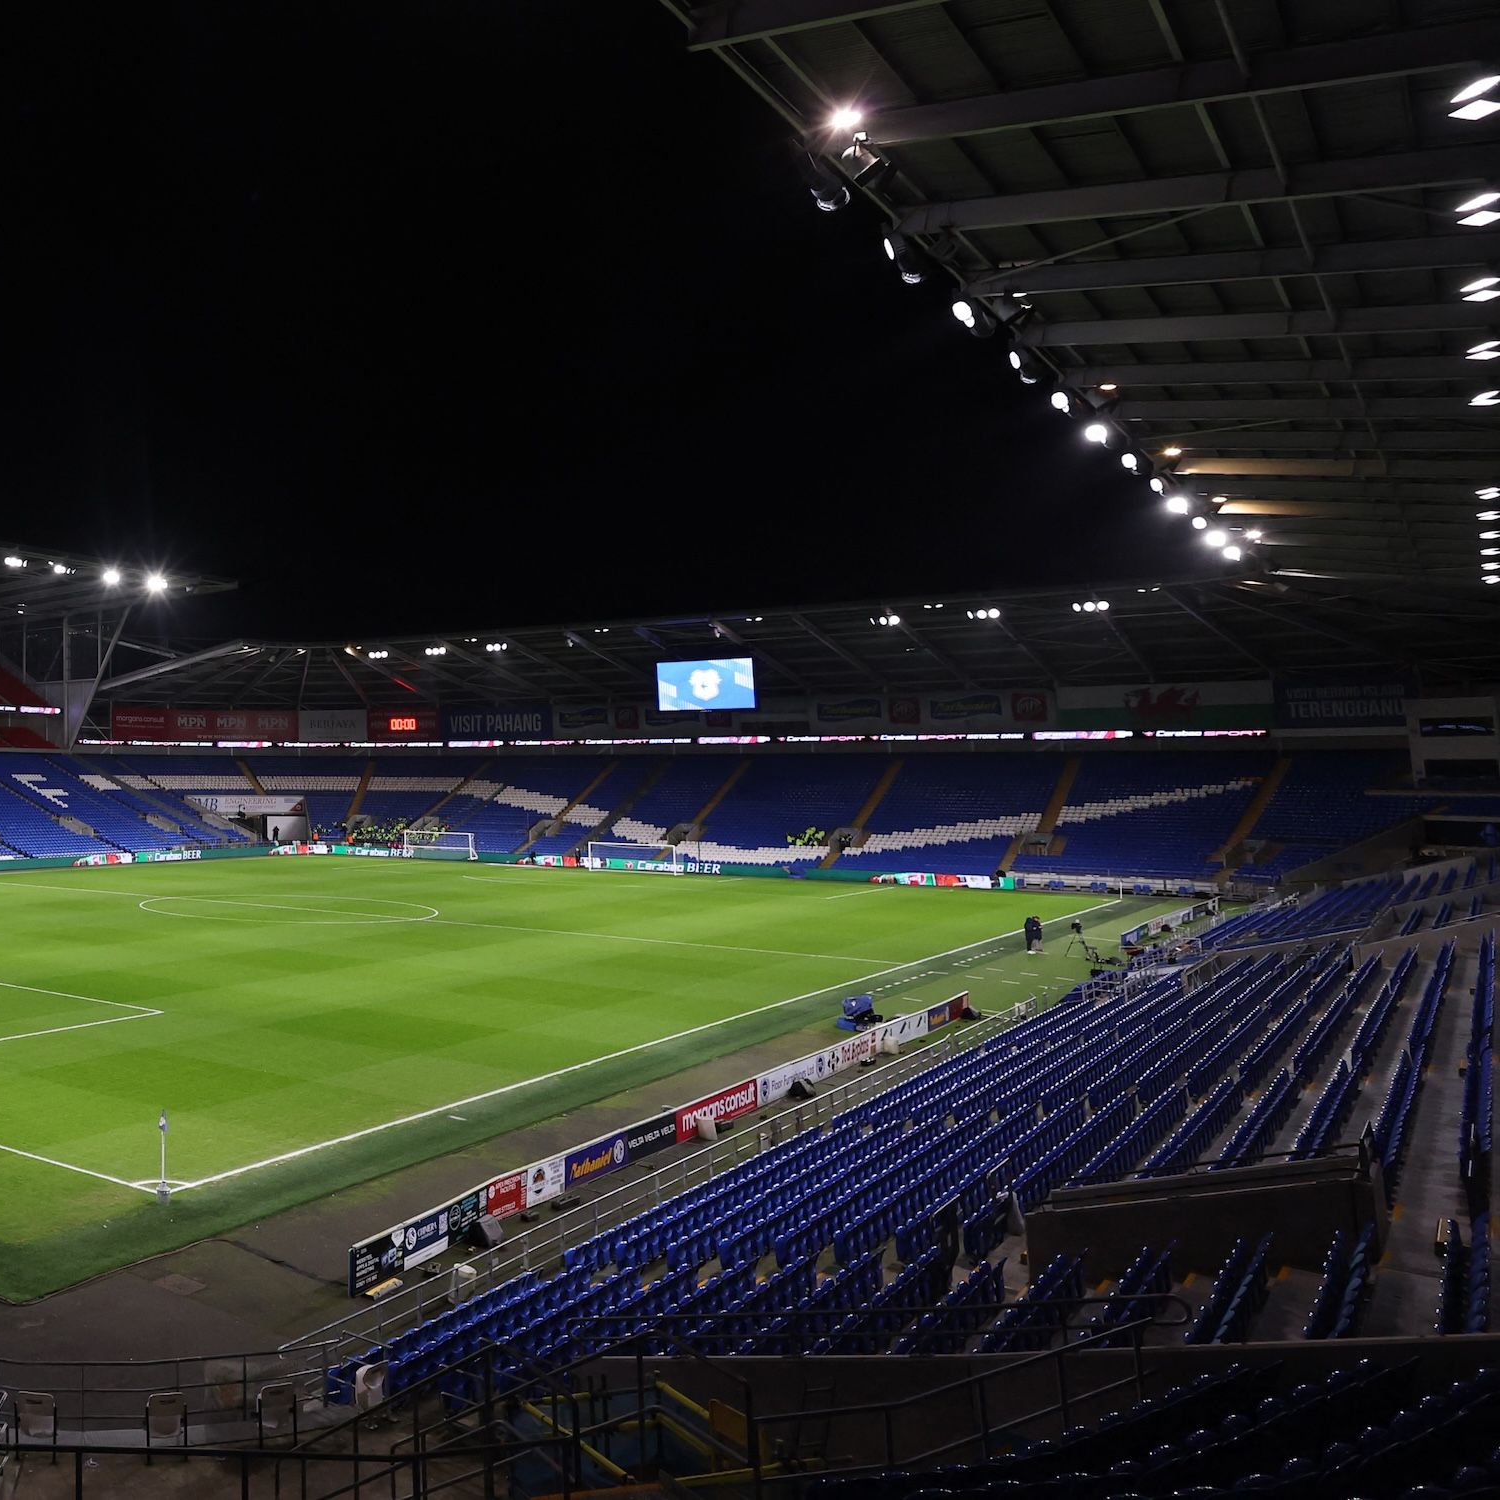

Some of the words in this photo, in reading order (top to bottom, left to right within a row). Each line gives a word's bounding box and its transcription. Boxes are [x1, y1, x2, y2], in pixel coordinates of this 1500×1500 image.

[1286, 699, 1405, 719] TERENGGANU
[177, 717, 207, 728] MPN
[217, 717, 247, 728] MPN
[258, 717, 289, 728] MPN
[390, 718, 416, 731] 00:00
[450, 714, 482, 733] VISIT
[486, 713, 542, 733] PAHANG
[225, 797, 277, 805] ENGINEERING
[155, 853, 182, 862] Carabao
[183, 850, 202, 860] BEER
[355, 848, 390, 857] Carabao
[637, 861, 685, 873] Carabao
[687, 862, 721, 874] BEER
[569, 1147, 613, 1181] Nathaniel
